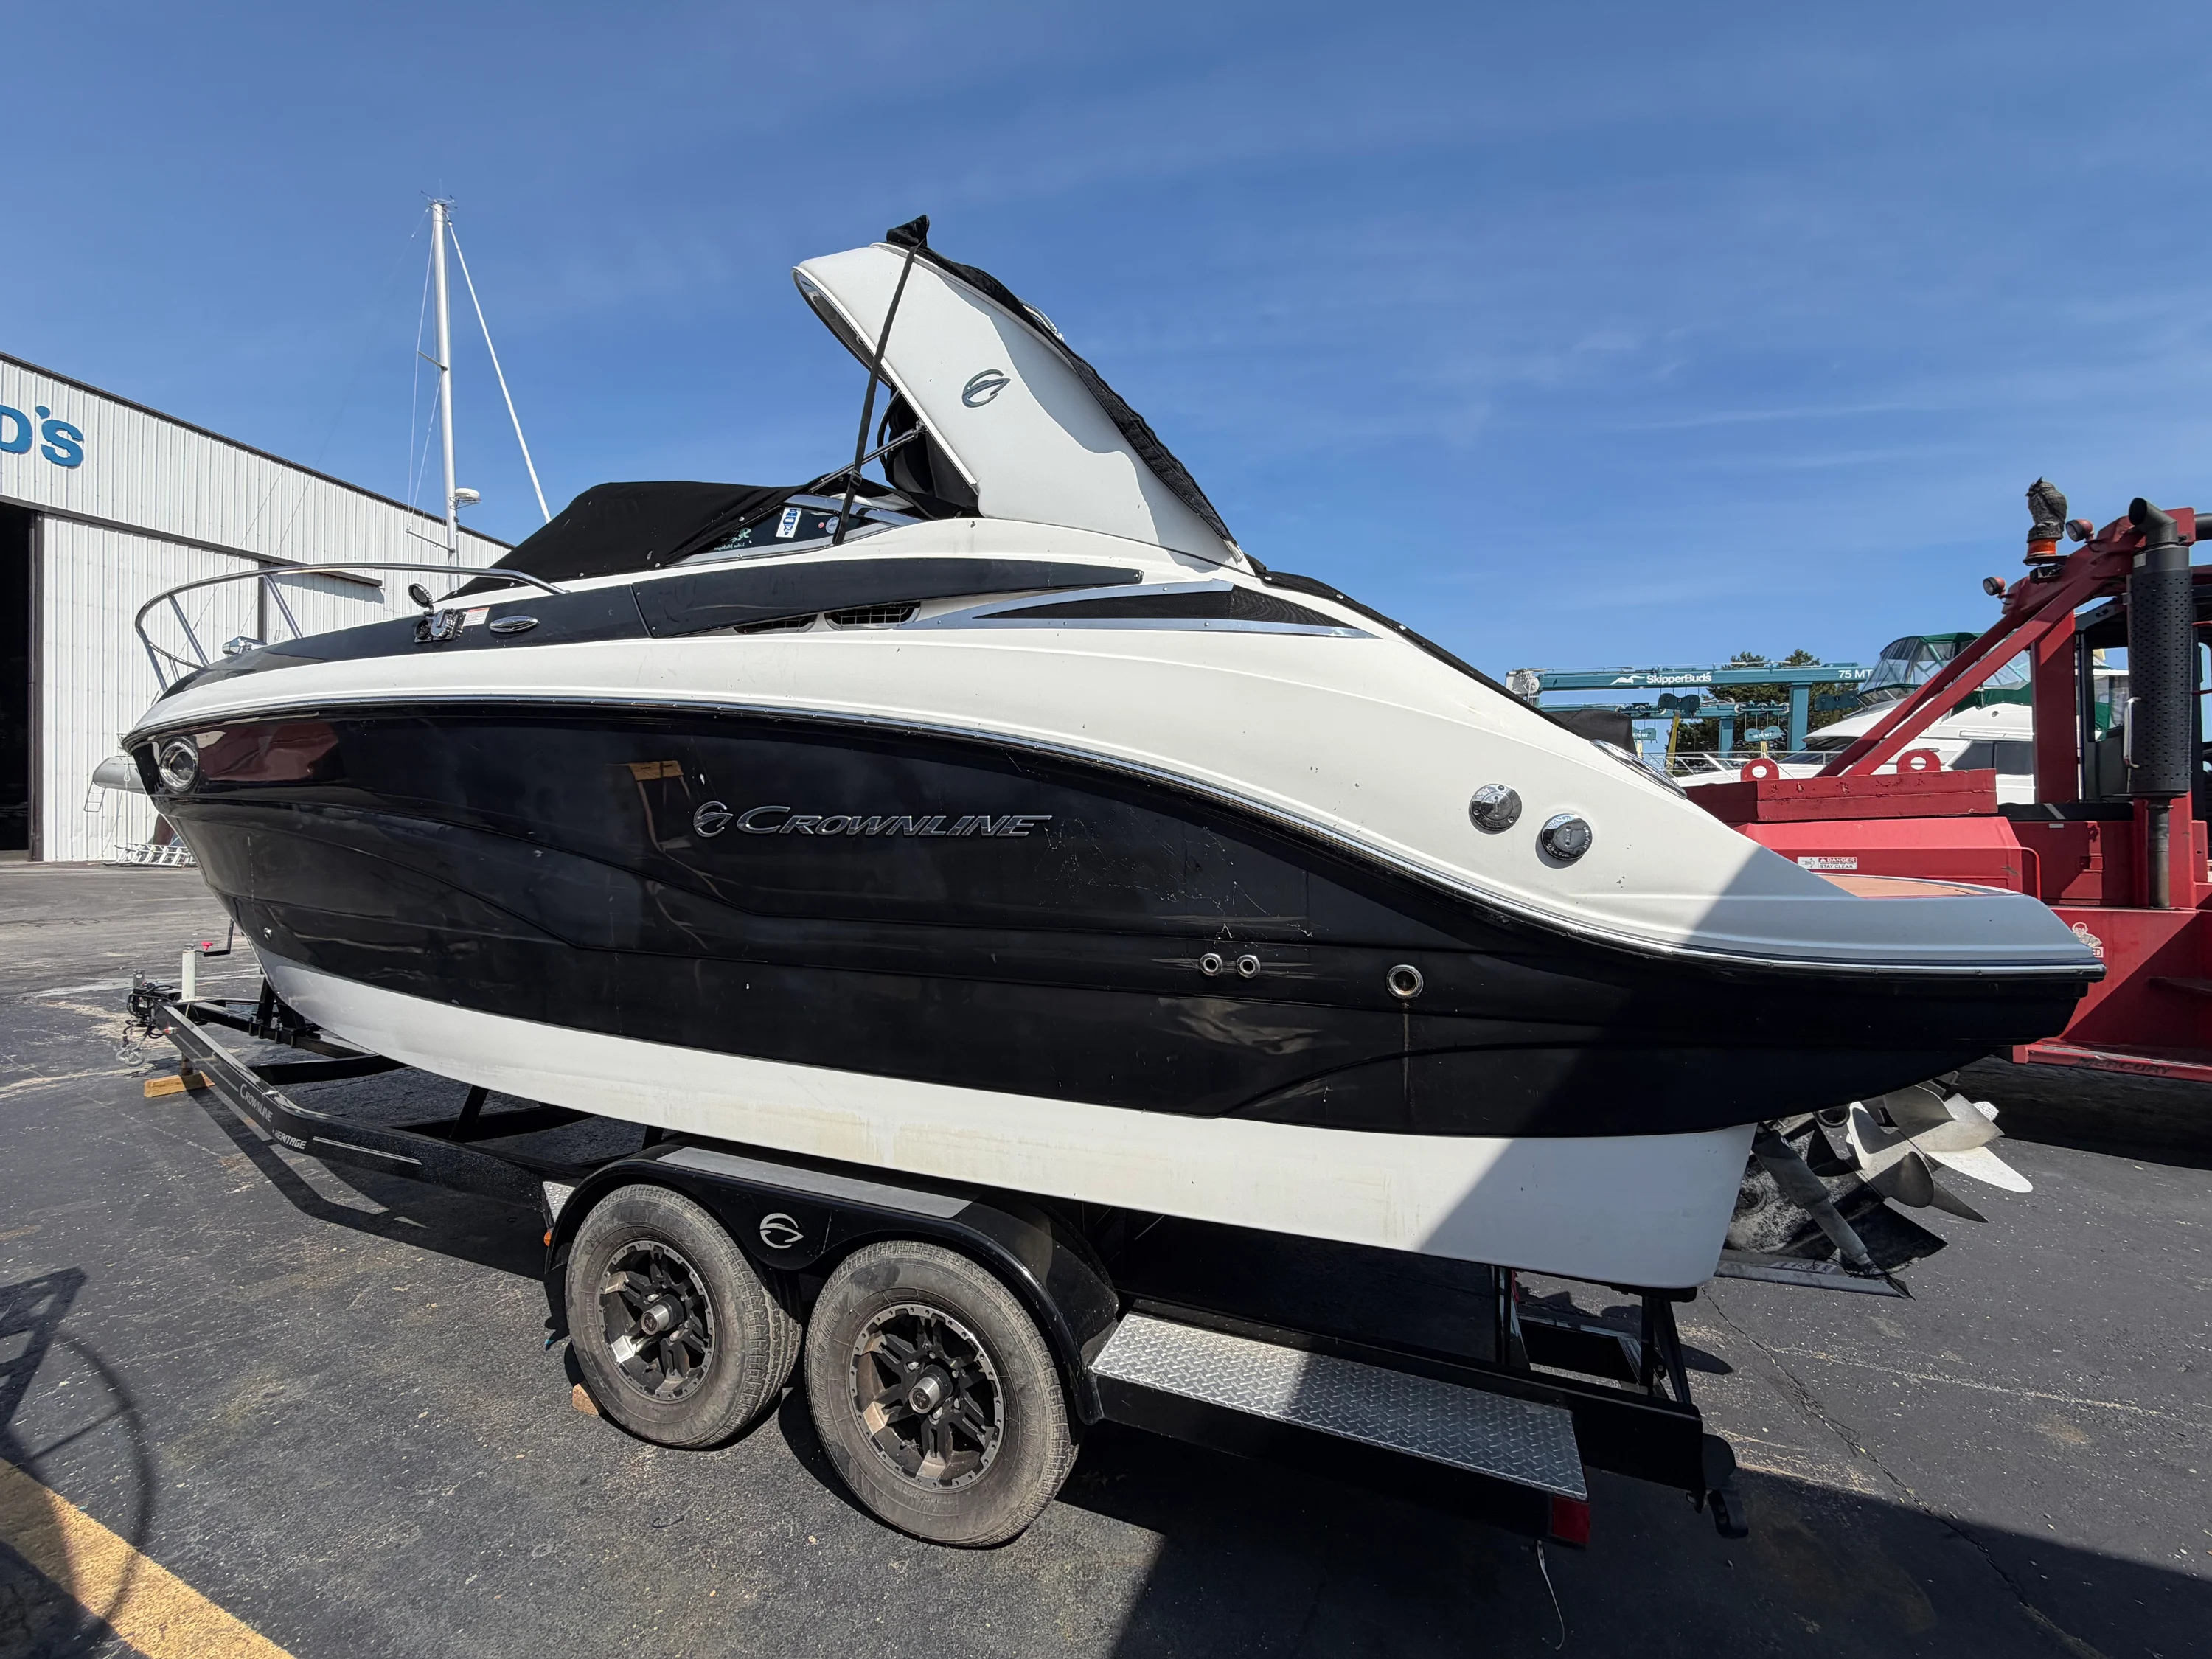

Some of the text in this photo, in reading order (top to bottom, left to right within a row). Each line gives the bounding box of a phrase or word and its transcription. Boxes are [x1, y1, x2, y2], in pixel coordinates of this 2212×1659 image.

[1838, 669, 1874, 679] 75 MT
[736, 805, 1053, 837] CROWNLINE
[240, 1083, 274, 1123] CROWNLINE
[274, 1129, 307, 1150] HERITAGE
